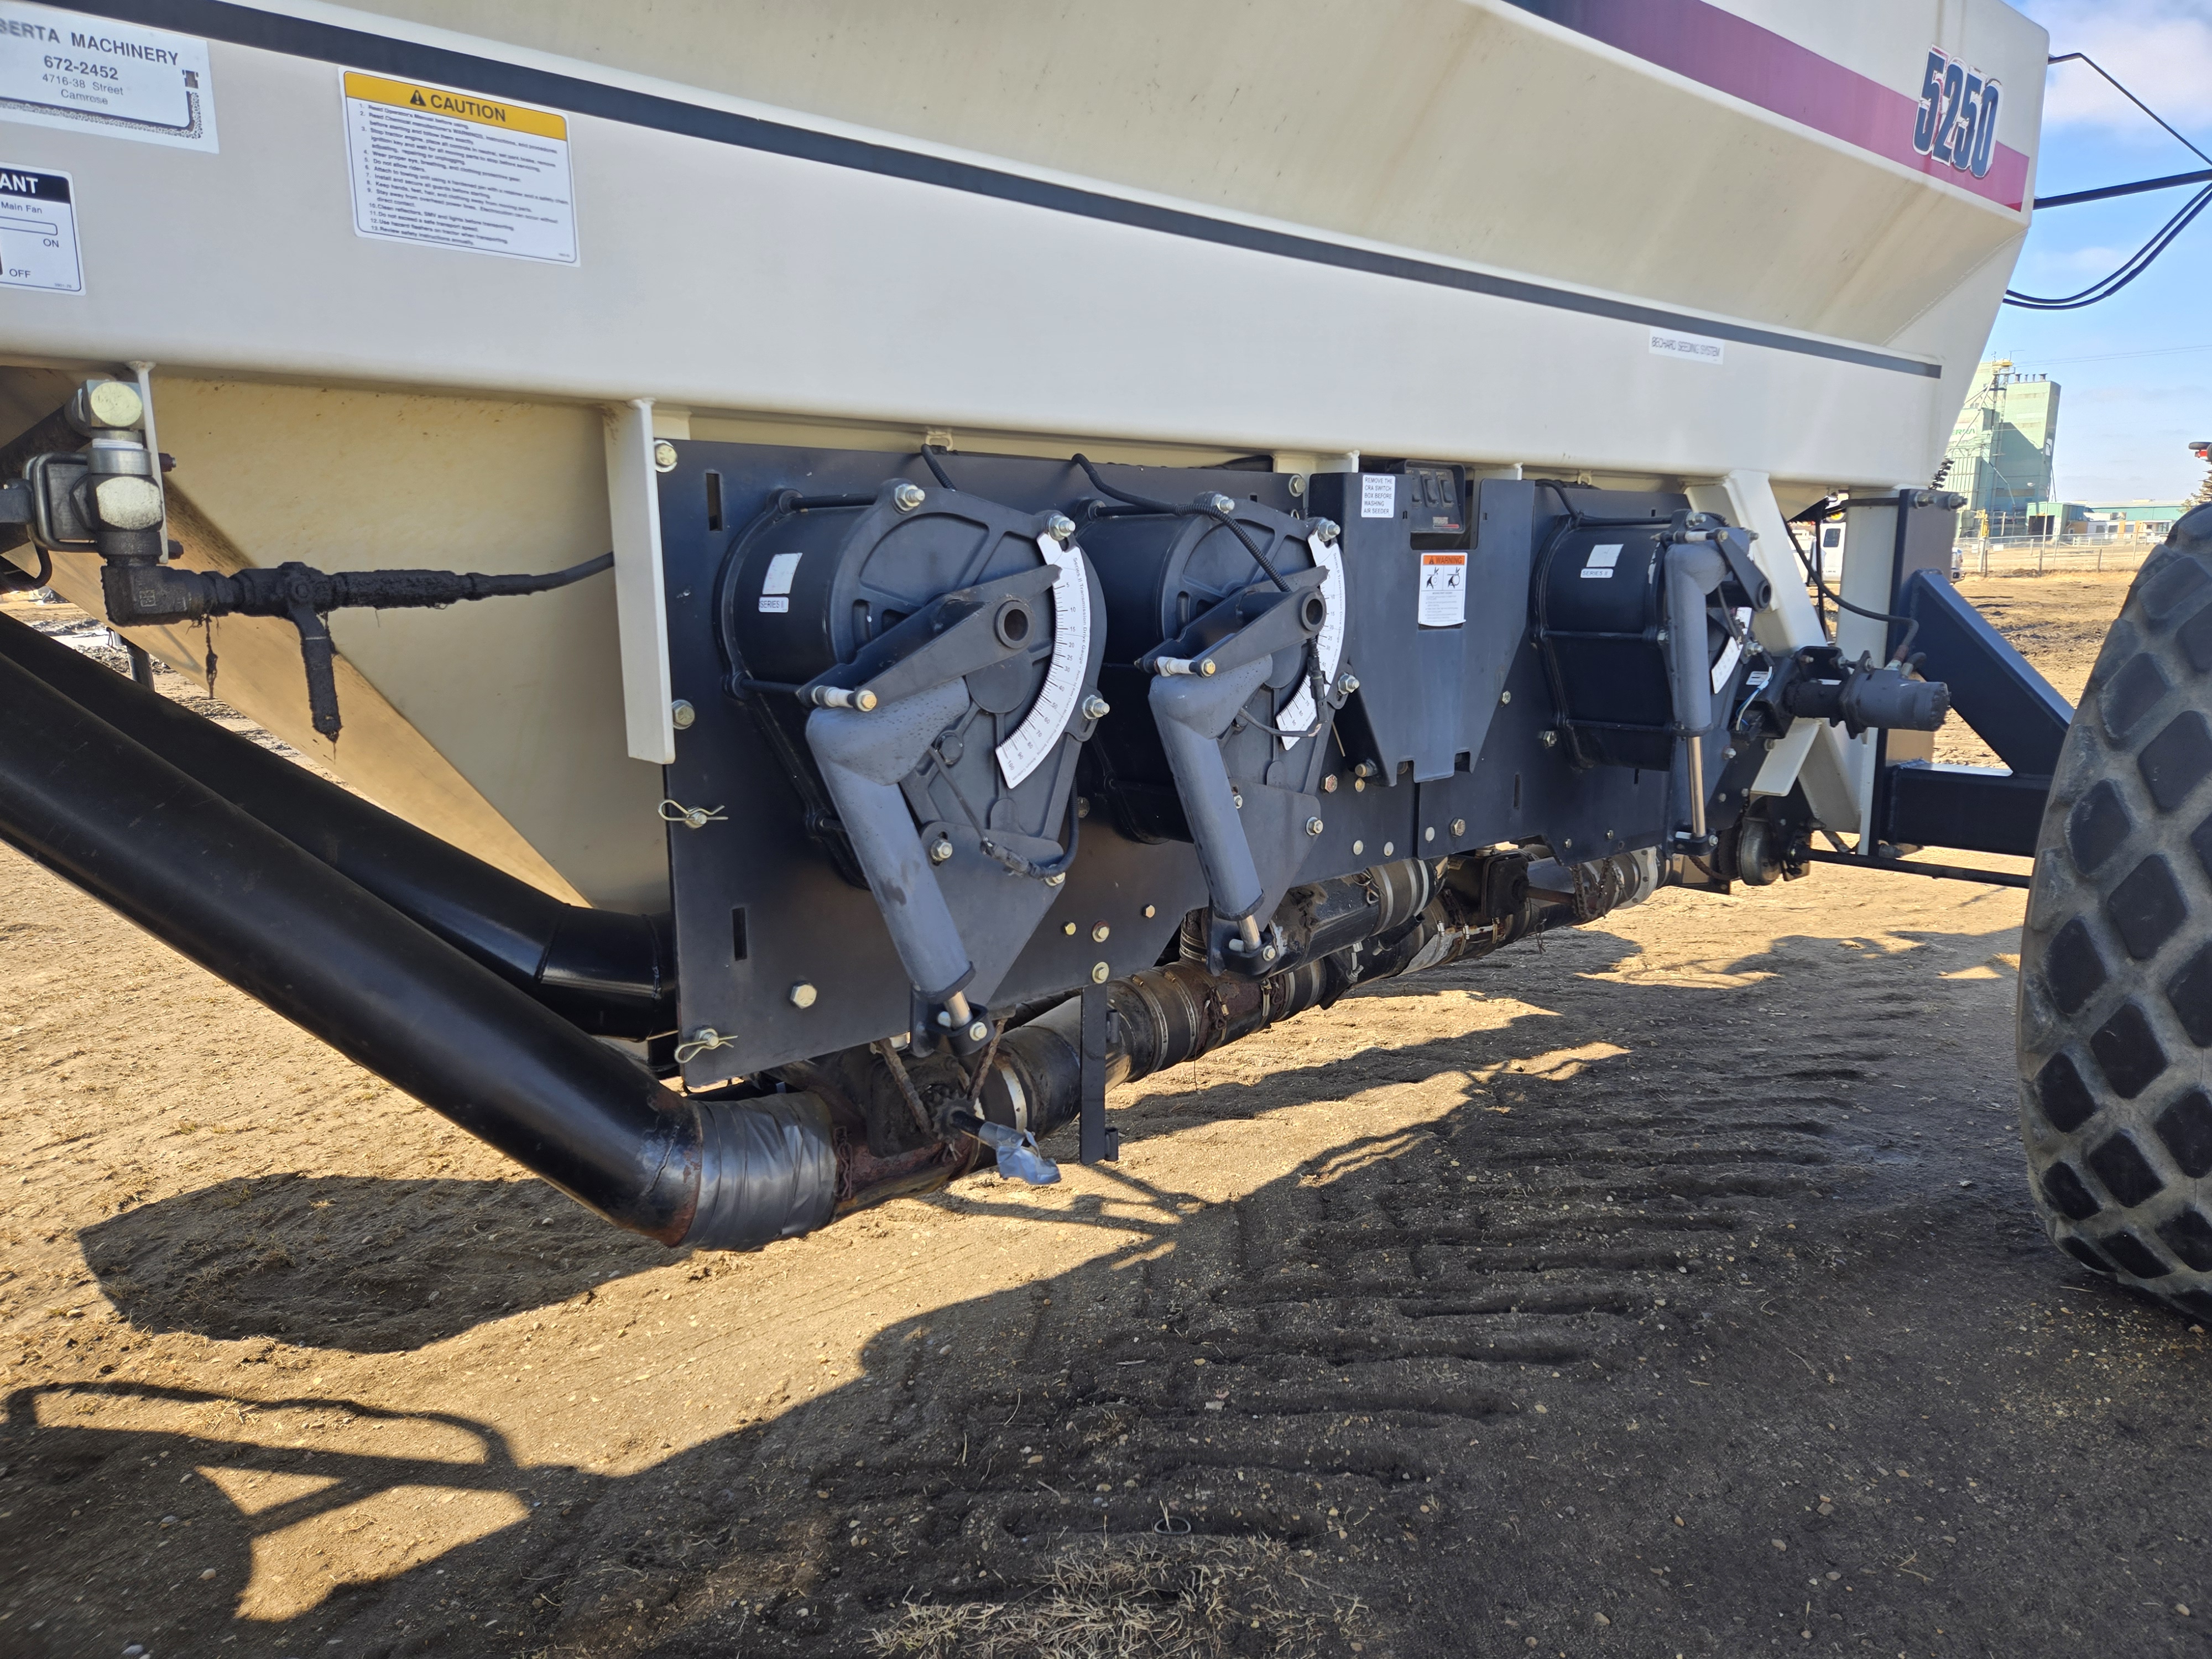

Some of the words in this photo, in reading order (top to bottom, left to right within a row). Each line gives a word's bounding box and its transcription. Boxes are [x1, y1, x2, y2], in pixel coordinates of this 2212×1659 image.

[71, 32, 179, 66] MACHINERY
[44, 55, 119, 81] 672-2452
[42, 74, 86, 89] 4716-38
[92, 81, 124, 96] Street
[61, 89, 109, 105] Camrose
[430, 94, 506, 122] CAUTION
[1913, 44, 2004, 179] 5250
[0, 173, 38, 194] ANT
[1, 201, 23, 212] Main
[26, 205, 43, 214] Fan
[43, 238, 59, 248] ON
[9, 268, 31, 278] OFF
